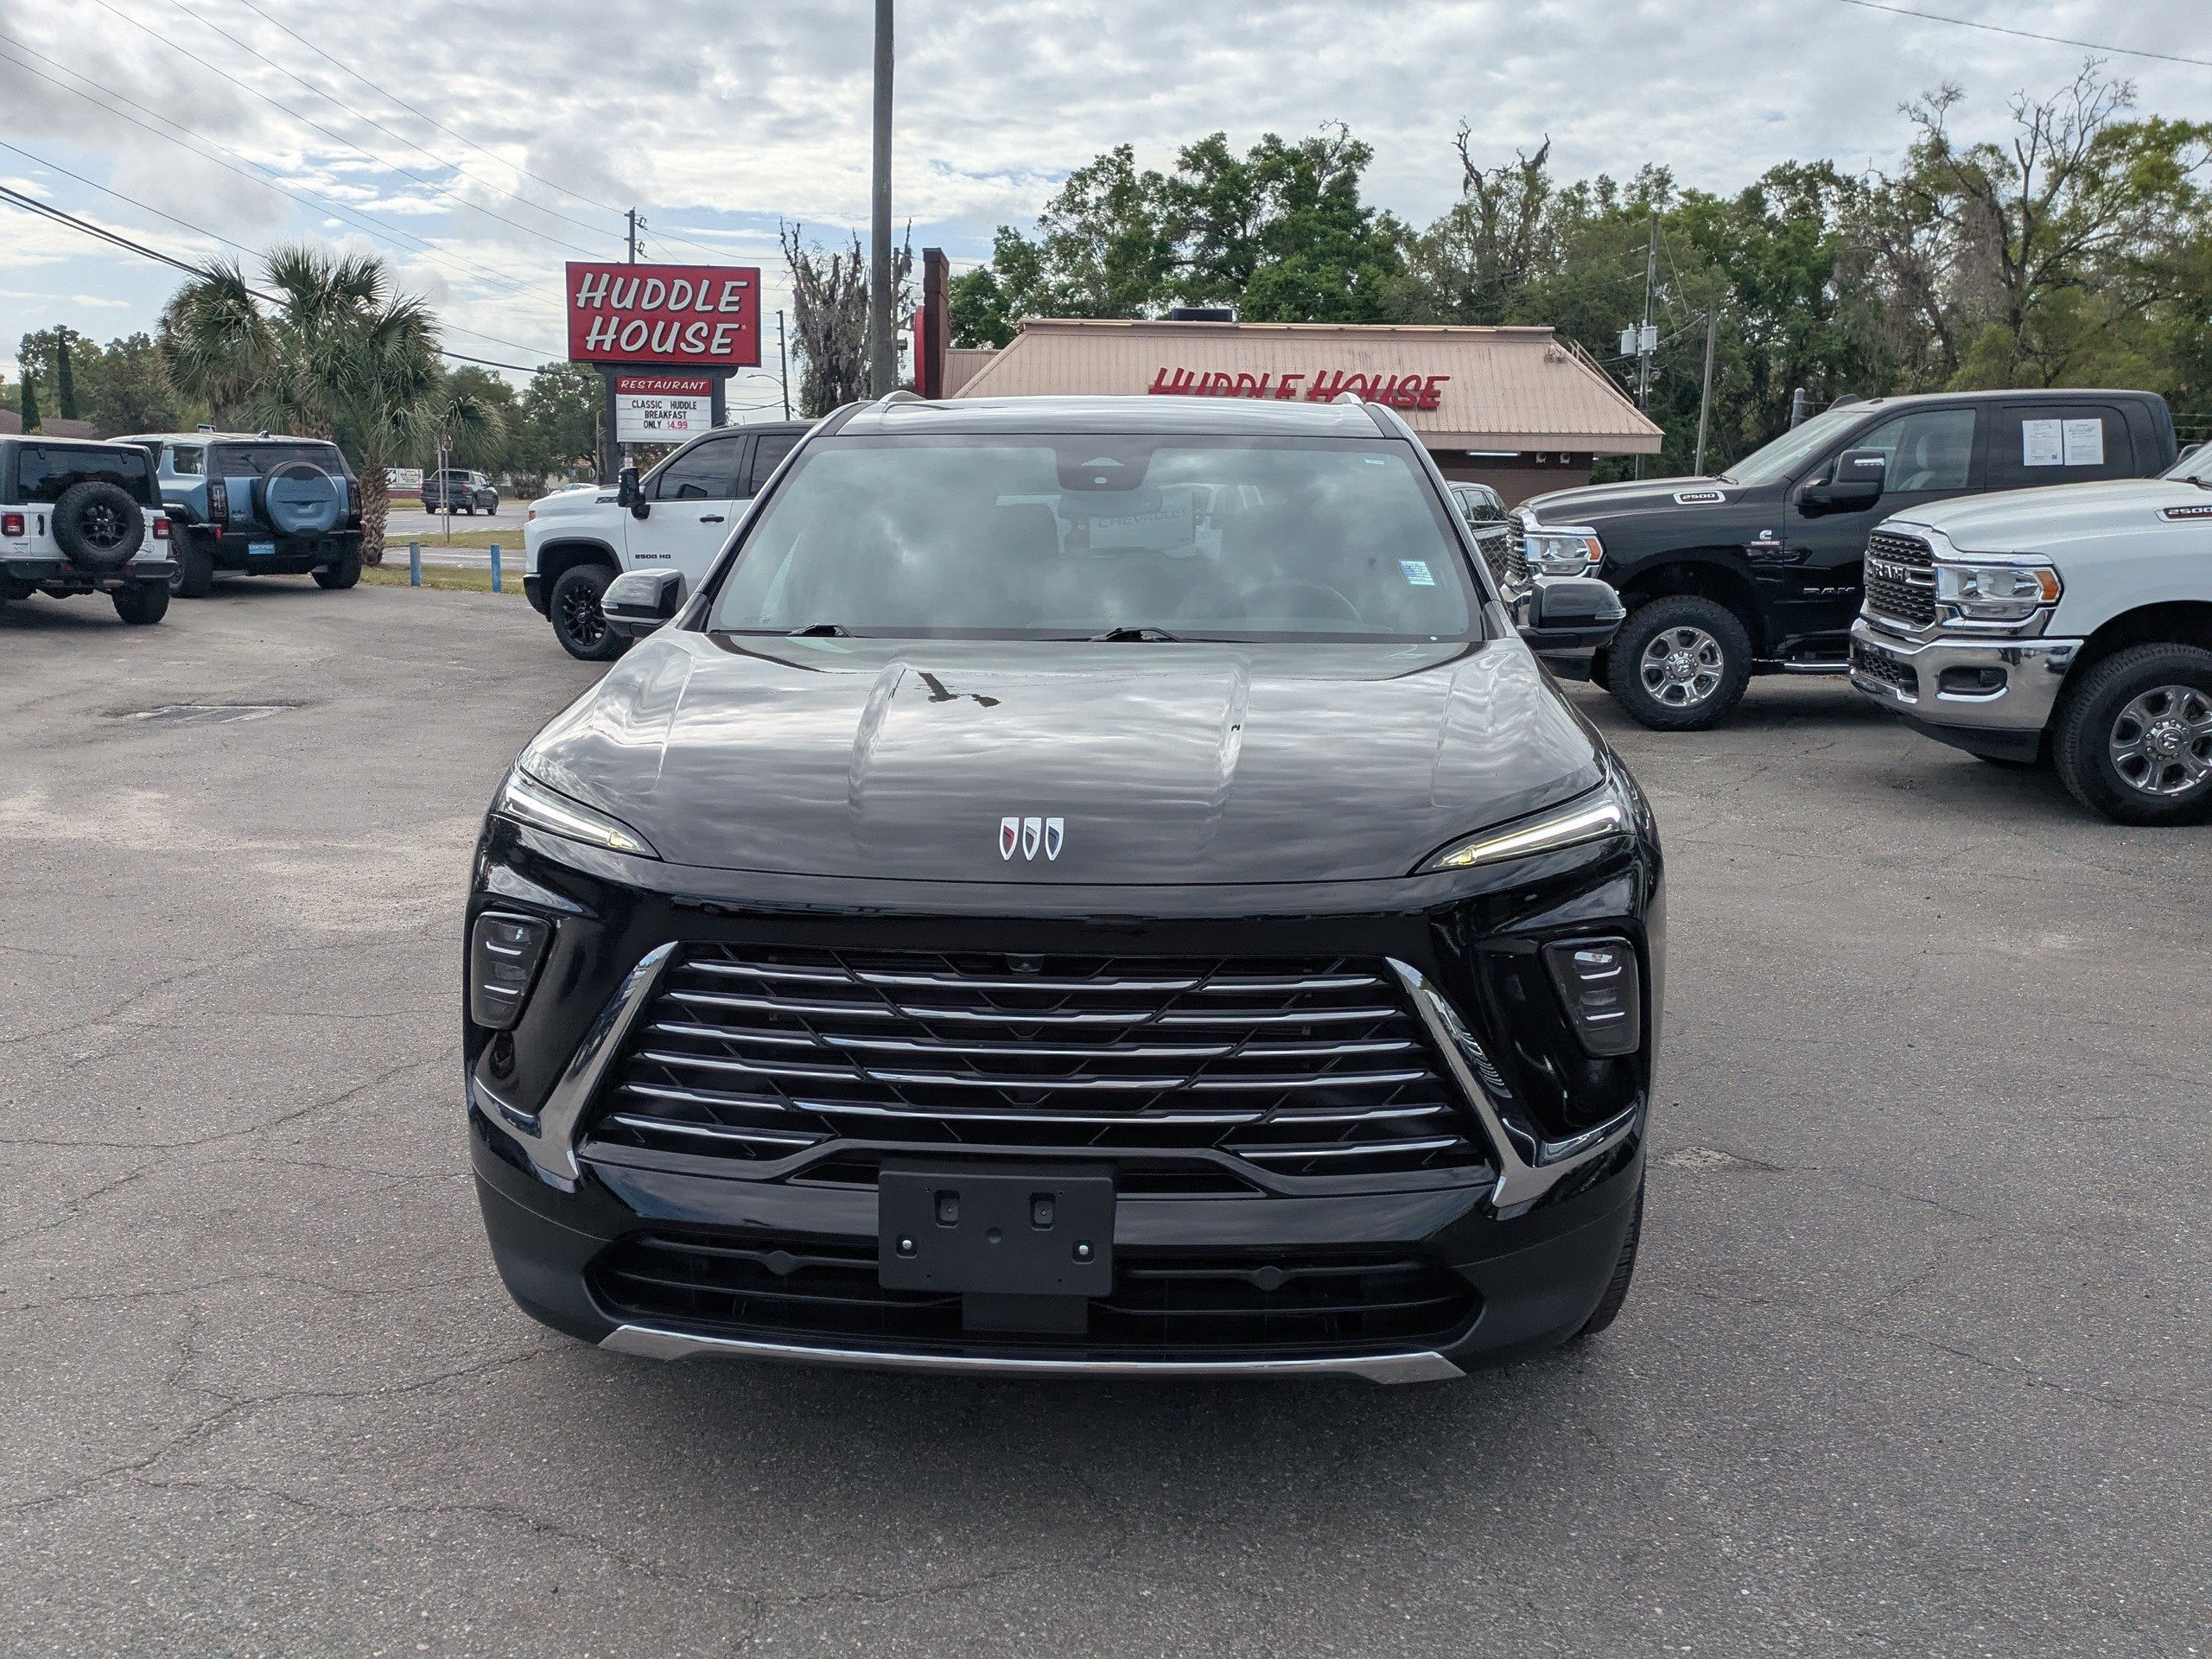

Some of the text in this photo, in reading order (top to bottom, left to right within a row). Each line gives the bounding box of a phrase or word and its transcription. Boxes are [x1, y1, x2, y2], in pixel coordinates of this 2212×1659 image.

[575, 272, 748, 312] HUDDLE
[585, 315, 740, 354] HOUSE
[620, 379, 706, 390] RESTAURANT
[1148, 367, 1451, 409] HUDDLE HOUSE
[632, 400, 697, 410] CLASSIC HUDDLE
[645, 410, 687, 420] BREAKFAST
[643, 420, 688, 429] ONLY $4.99
